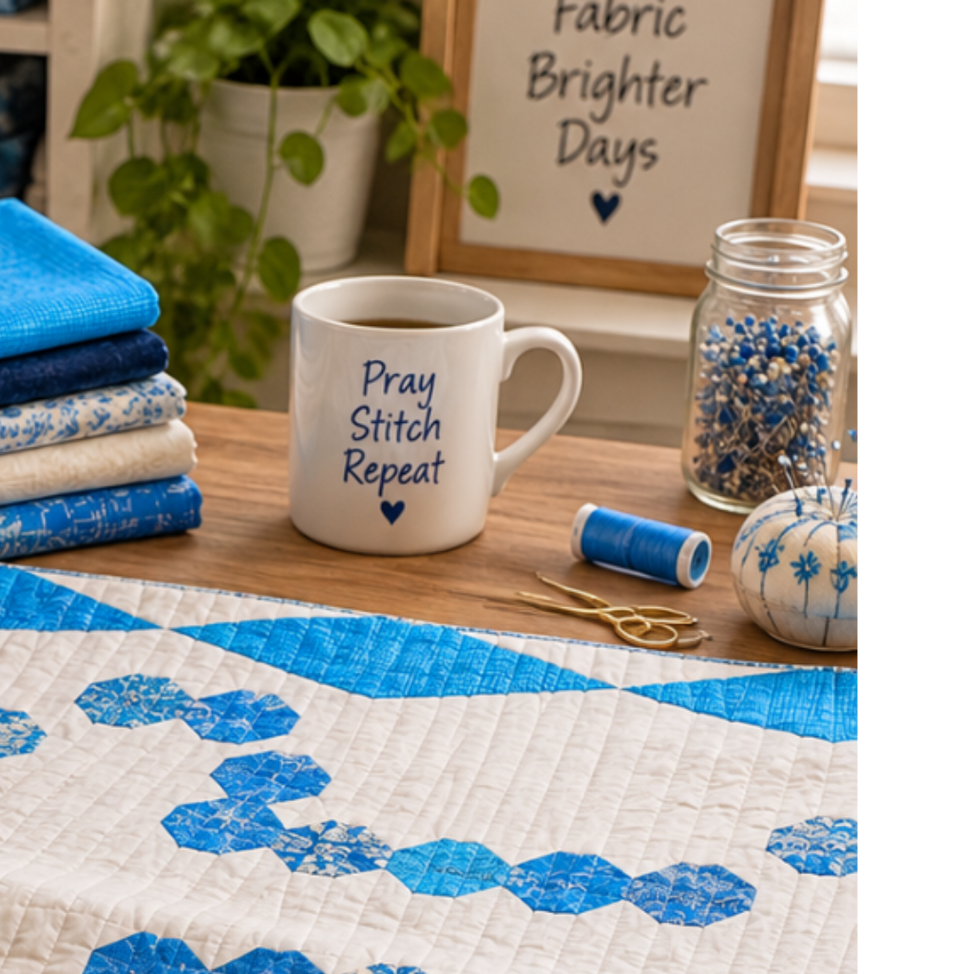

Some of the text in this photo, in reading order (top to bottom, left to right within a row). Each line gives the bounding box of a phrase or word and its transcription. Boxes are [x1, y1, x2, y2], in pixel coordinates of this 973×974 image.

[553, 0, 687, 39] Fabric
[526, 49, 708, 125] Brighter
[555, 117, 659, 189] Days
[362, 359, 438, 411] Pray
[350, 405, 442, 444] Stitch
[342, 446, 446, 497] Repeat
